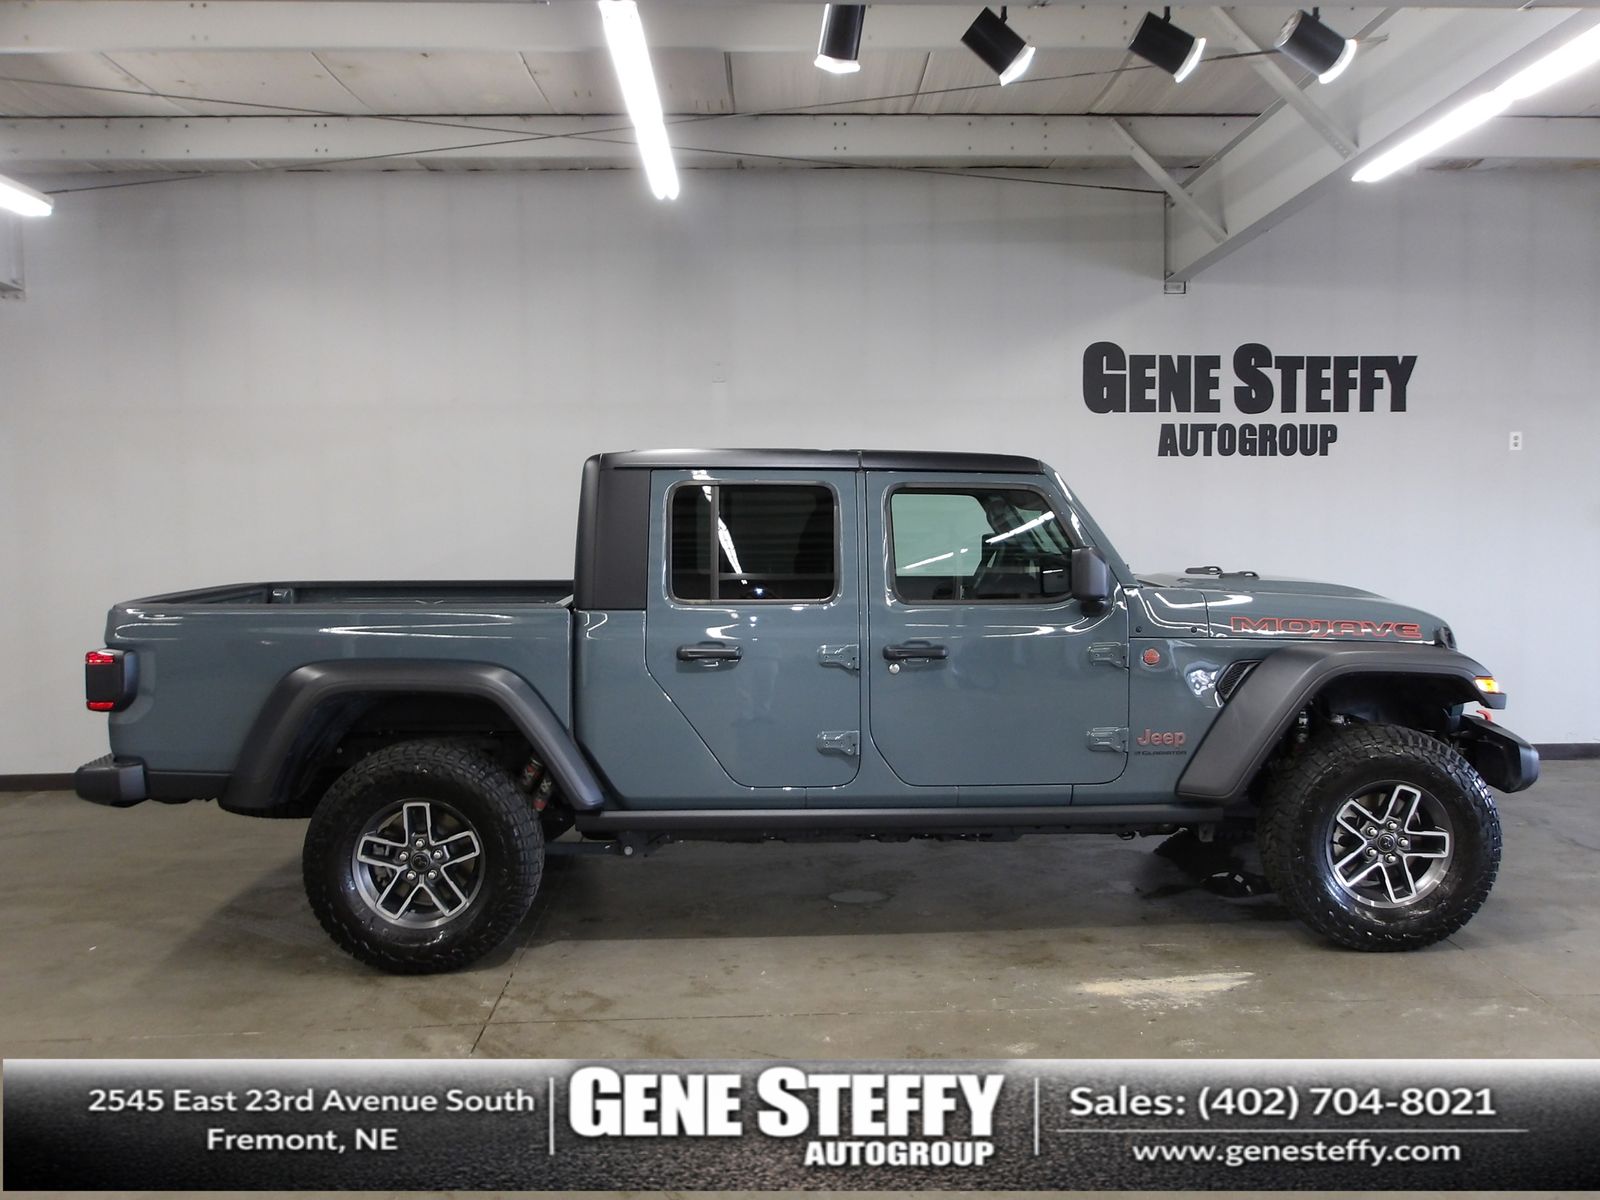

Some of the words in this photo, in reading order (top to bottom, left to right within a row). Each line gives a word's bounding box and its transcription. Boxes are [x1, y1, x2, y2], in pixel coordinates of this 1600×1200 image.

[1083, 342, 1221, 414] GENE
[1232, 342, 1418, 414] STEFFY
[1157, 423, 1338, 457] AUTOGROUP
[1231, 617, 1422, 638] MOJAVE
[1137, 728, 1185, 746] Jeep
